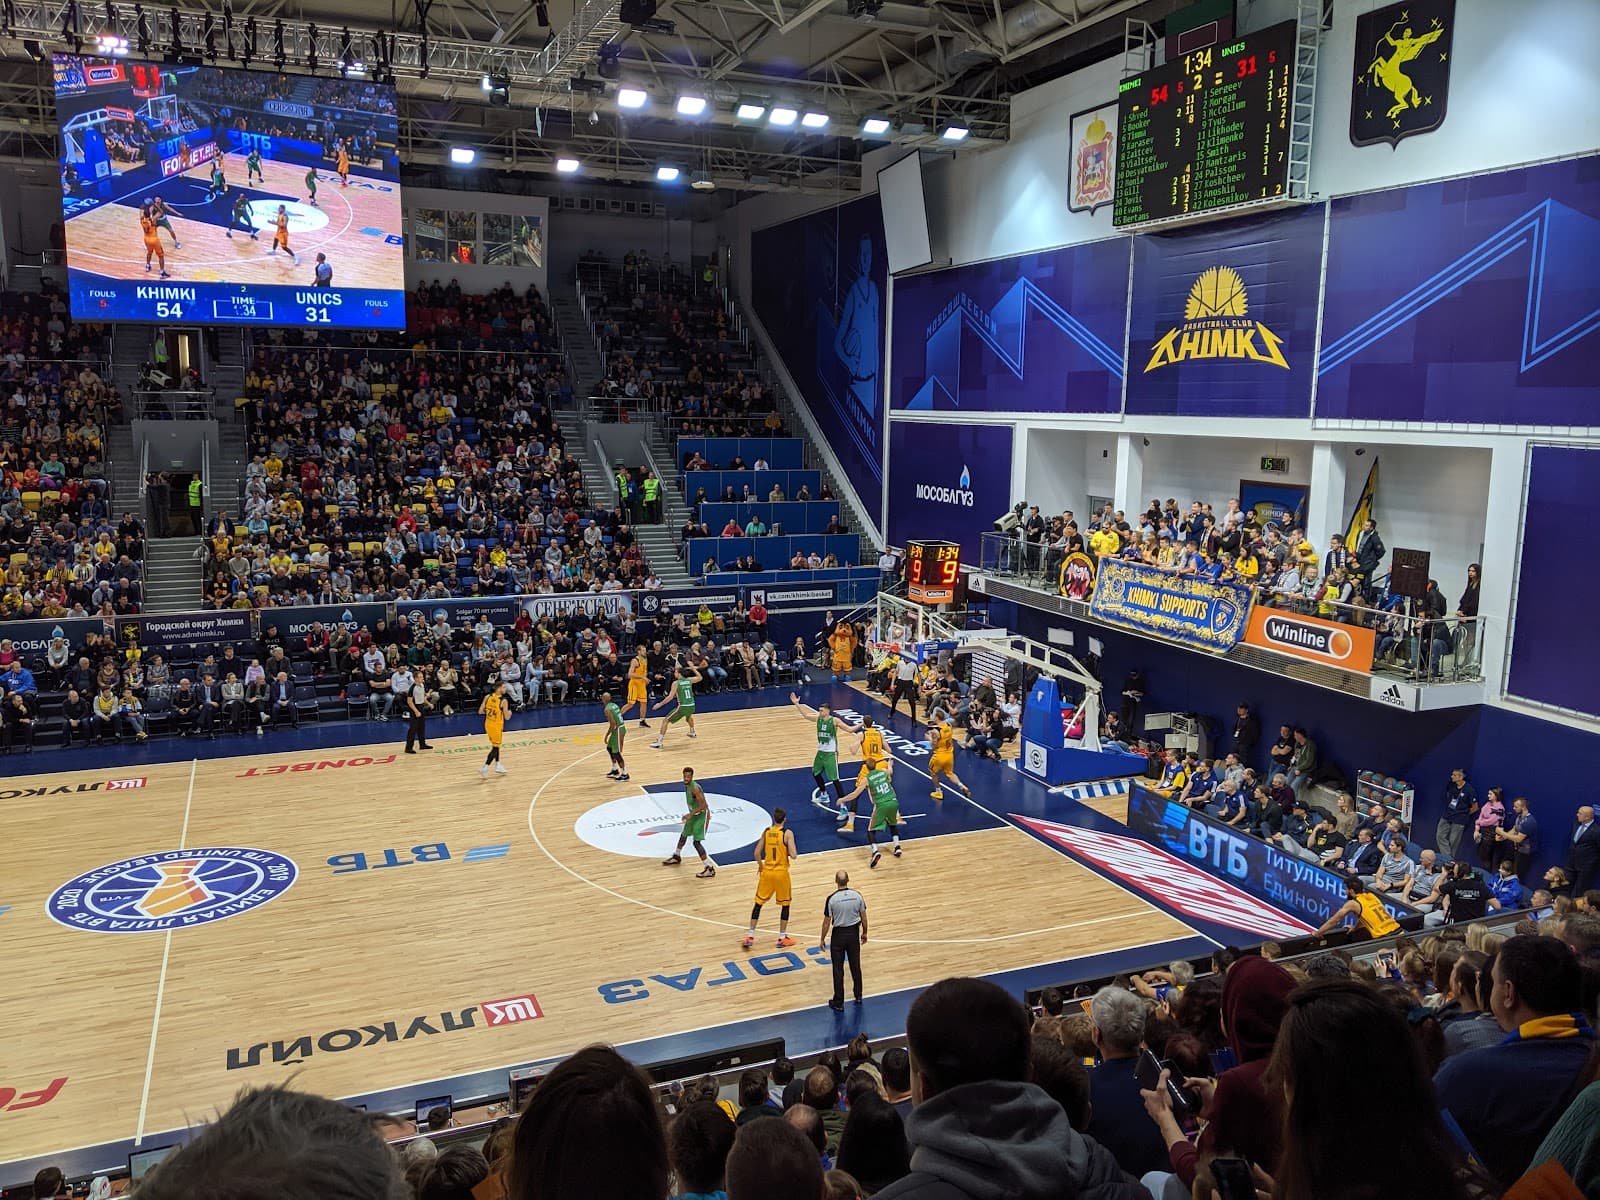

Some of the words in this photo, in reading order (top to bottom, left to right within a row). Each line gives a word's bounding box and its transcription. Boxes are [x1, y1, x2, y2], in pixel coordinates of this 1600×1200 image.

[1222, 42, 1246, 57] UNICS
[1184, 48, 1212, 74] 1:34
[1236, 55, 1257, 78] 31
[1194, 74, 1202, 90] 2
[1210, 81, 1242, 97] Sergeev
[1269, 70, 1274, 79] 1
[1284, 64, 1288, 74] 1
[1268, 80, 1272, 90] 3
[1282, 76, 1288, 86] 1
[1151, 84, 1168, 105] 54
[1186, 94, 1194, 104] 11
[1268, 91, 1272, 100] 1
[1278, 86, 1288, 98] 12
[1176, 108, 1182, 117] 2
[1186, 104, 1194, 114] 11
[1266, 102, 1272, 112] 1
[1280, 98, 1286, 108] 2
[1280, 108, 1286, 118] 2
[1176, 128, 1180, 137] 3
[1266, 123, 1270, 133] 1
[242, 133, 272, 150] ВТБ
[1175, 138, 1180, 146] 2
[1206, 144, 1229, 158] Smith
[1264, 134, 1270, 144] 1
[1264, 144, 1269, 154] 3
[1263, 155, 1268, 165] 1
[1278, 152, 1284, 162] 7
[1262, 166, 1268, 176] 1
[1172, 176, 1178, 186] 2
[1182, 174, 1190, 184] 12
[1172, 186, 1177, 196] 3
[1184, 184, 1190, 192] 3
[1261, 186, 1266, 196] 1
[1276, 184, 1282, 194] 2
[1172, 196, 1176, 205] 2
[1184, 194, 1189, 202] 2
[1184, 204, 1188, 212] 3
[90, 289, 116, 298] FOULS
[136, 286, 196, 300] KHIMKI
[231, 296, 256, 304] TIME
[296, 292, 342, 306] UNICS
[156, 302, 183, 318] 54
[364, 299, 388, 308] FOULS
[305, 307, 331, 323] 31
[926, 292, 960, 338] MOSCOW
[962, 292, 996, 336] REGION
[1184, 320, 1230, 330] BASKETBALL
[1232, 320, 1252, 328] CLUB
[1144, 321, 1290, 374] KHIMKI
[938, 547, 960, 560] 1:34
[913, 560, 922, 582] 9
[943, 561, 958, 583] 9
[535, 597, 620, 618] СЕНЕЖСКАЯ
[1128, 586, 1159, 609] KHIMKI
[1162, 595, 1208, 620] SUPPORTS
[146, 620, 190, 632] Городской
[192, 620, 215, 630] округ
[216, 618, 244, 627] Химки
[290, 622, 358, 633] МОСБЛГАЗ
[162, 630, 224, 640] www.admhimki.ru
[1270, 621, 1326, 648] Winline
[1380, 694, 1404, 706] adidas
[833, 708, 929, 756] МОСБЛГАЗ
[870, 744, 878, 754] 10
[236, 754, 397, 778] FONBET
[877, 782, 890, 794] 42
[164, 850, 240, 860] UNITED
[242, 851, 273, 863] VTB
[772, 848, 776, 860] 1
[1188, 819, 1249, 881] ВТБ
[326, 842, 452, 874] ВТБ
[80, 855, 162, 884] LEAGUE
[268, 864, 290, 881] 2019
[1264, 845, 1348, 898] Титульны
[57, 888, 84, 910] 2020
[1264, 872, 1330, 920] Единой
[184, 889, 276, 924] ЕДИНАЯ
[68, 912, 106, 926] ВТБ
[109, 917, 176, 928] ЛИГА
[226, 1006, 478, 1070] ЛУКОЙЛ
